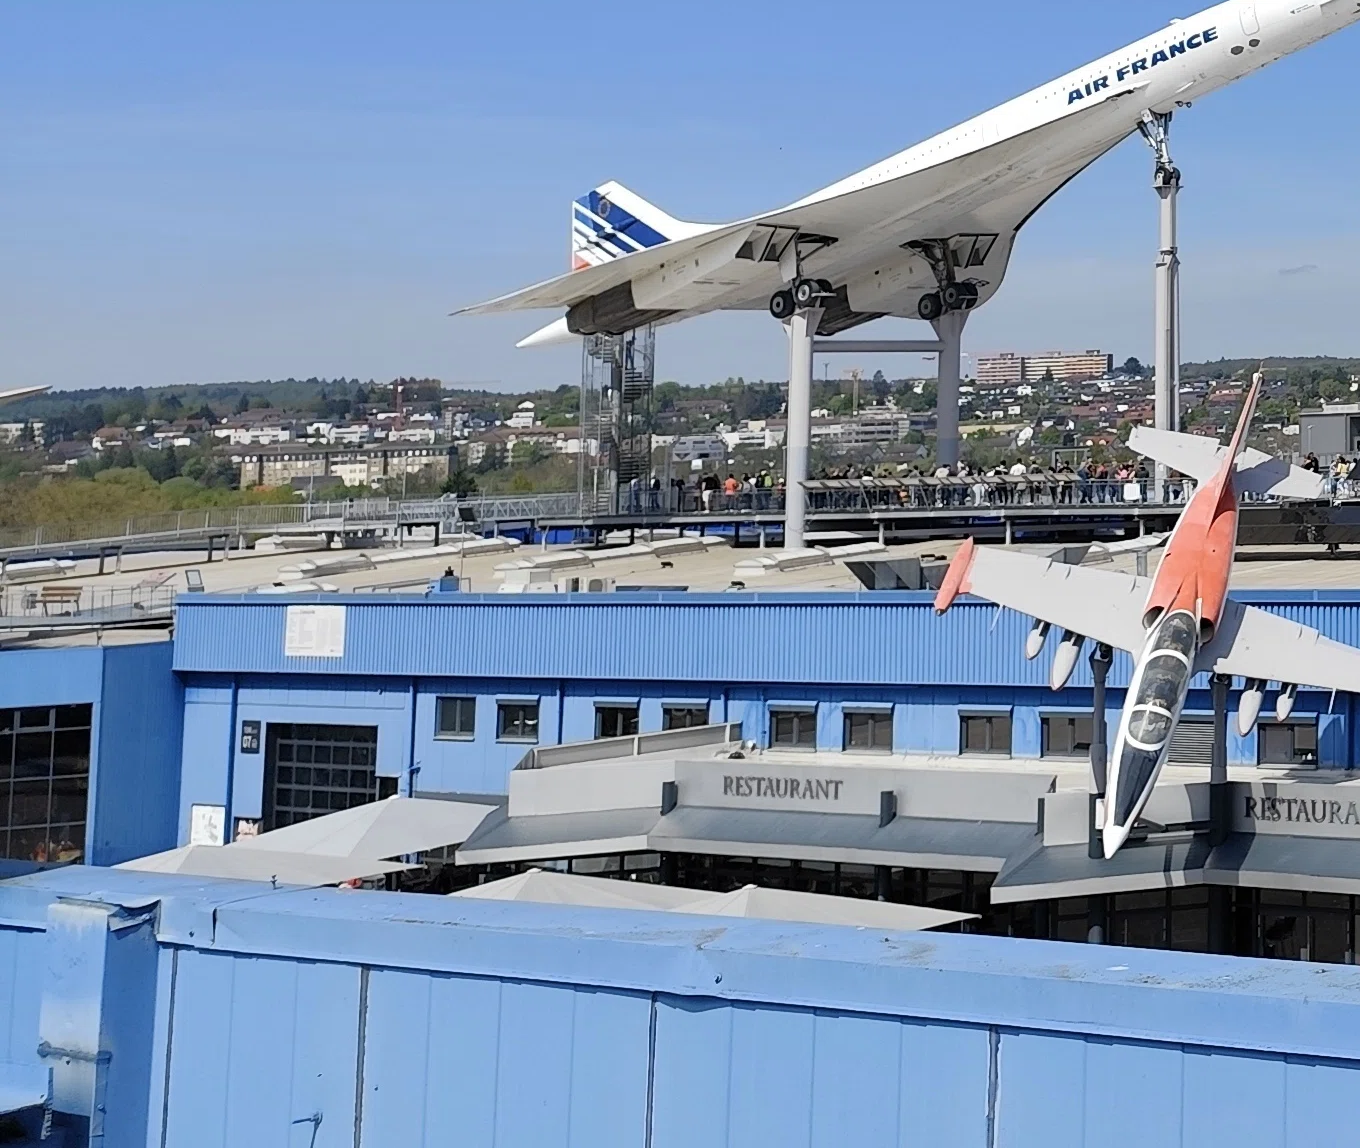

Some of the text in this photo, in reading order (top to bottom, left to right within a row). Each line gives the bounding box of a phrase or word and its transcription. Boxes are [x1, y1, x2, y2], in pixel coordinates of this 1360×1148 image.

[1067, 26, 1218, 105] AIR FRANCE
[723, 775, 844, 801] RESTAURANT
